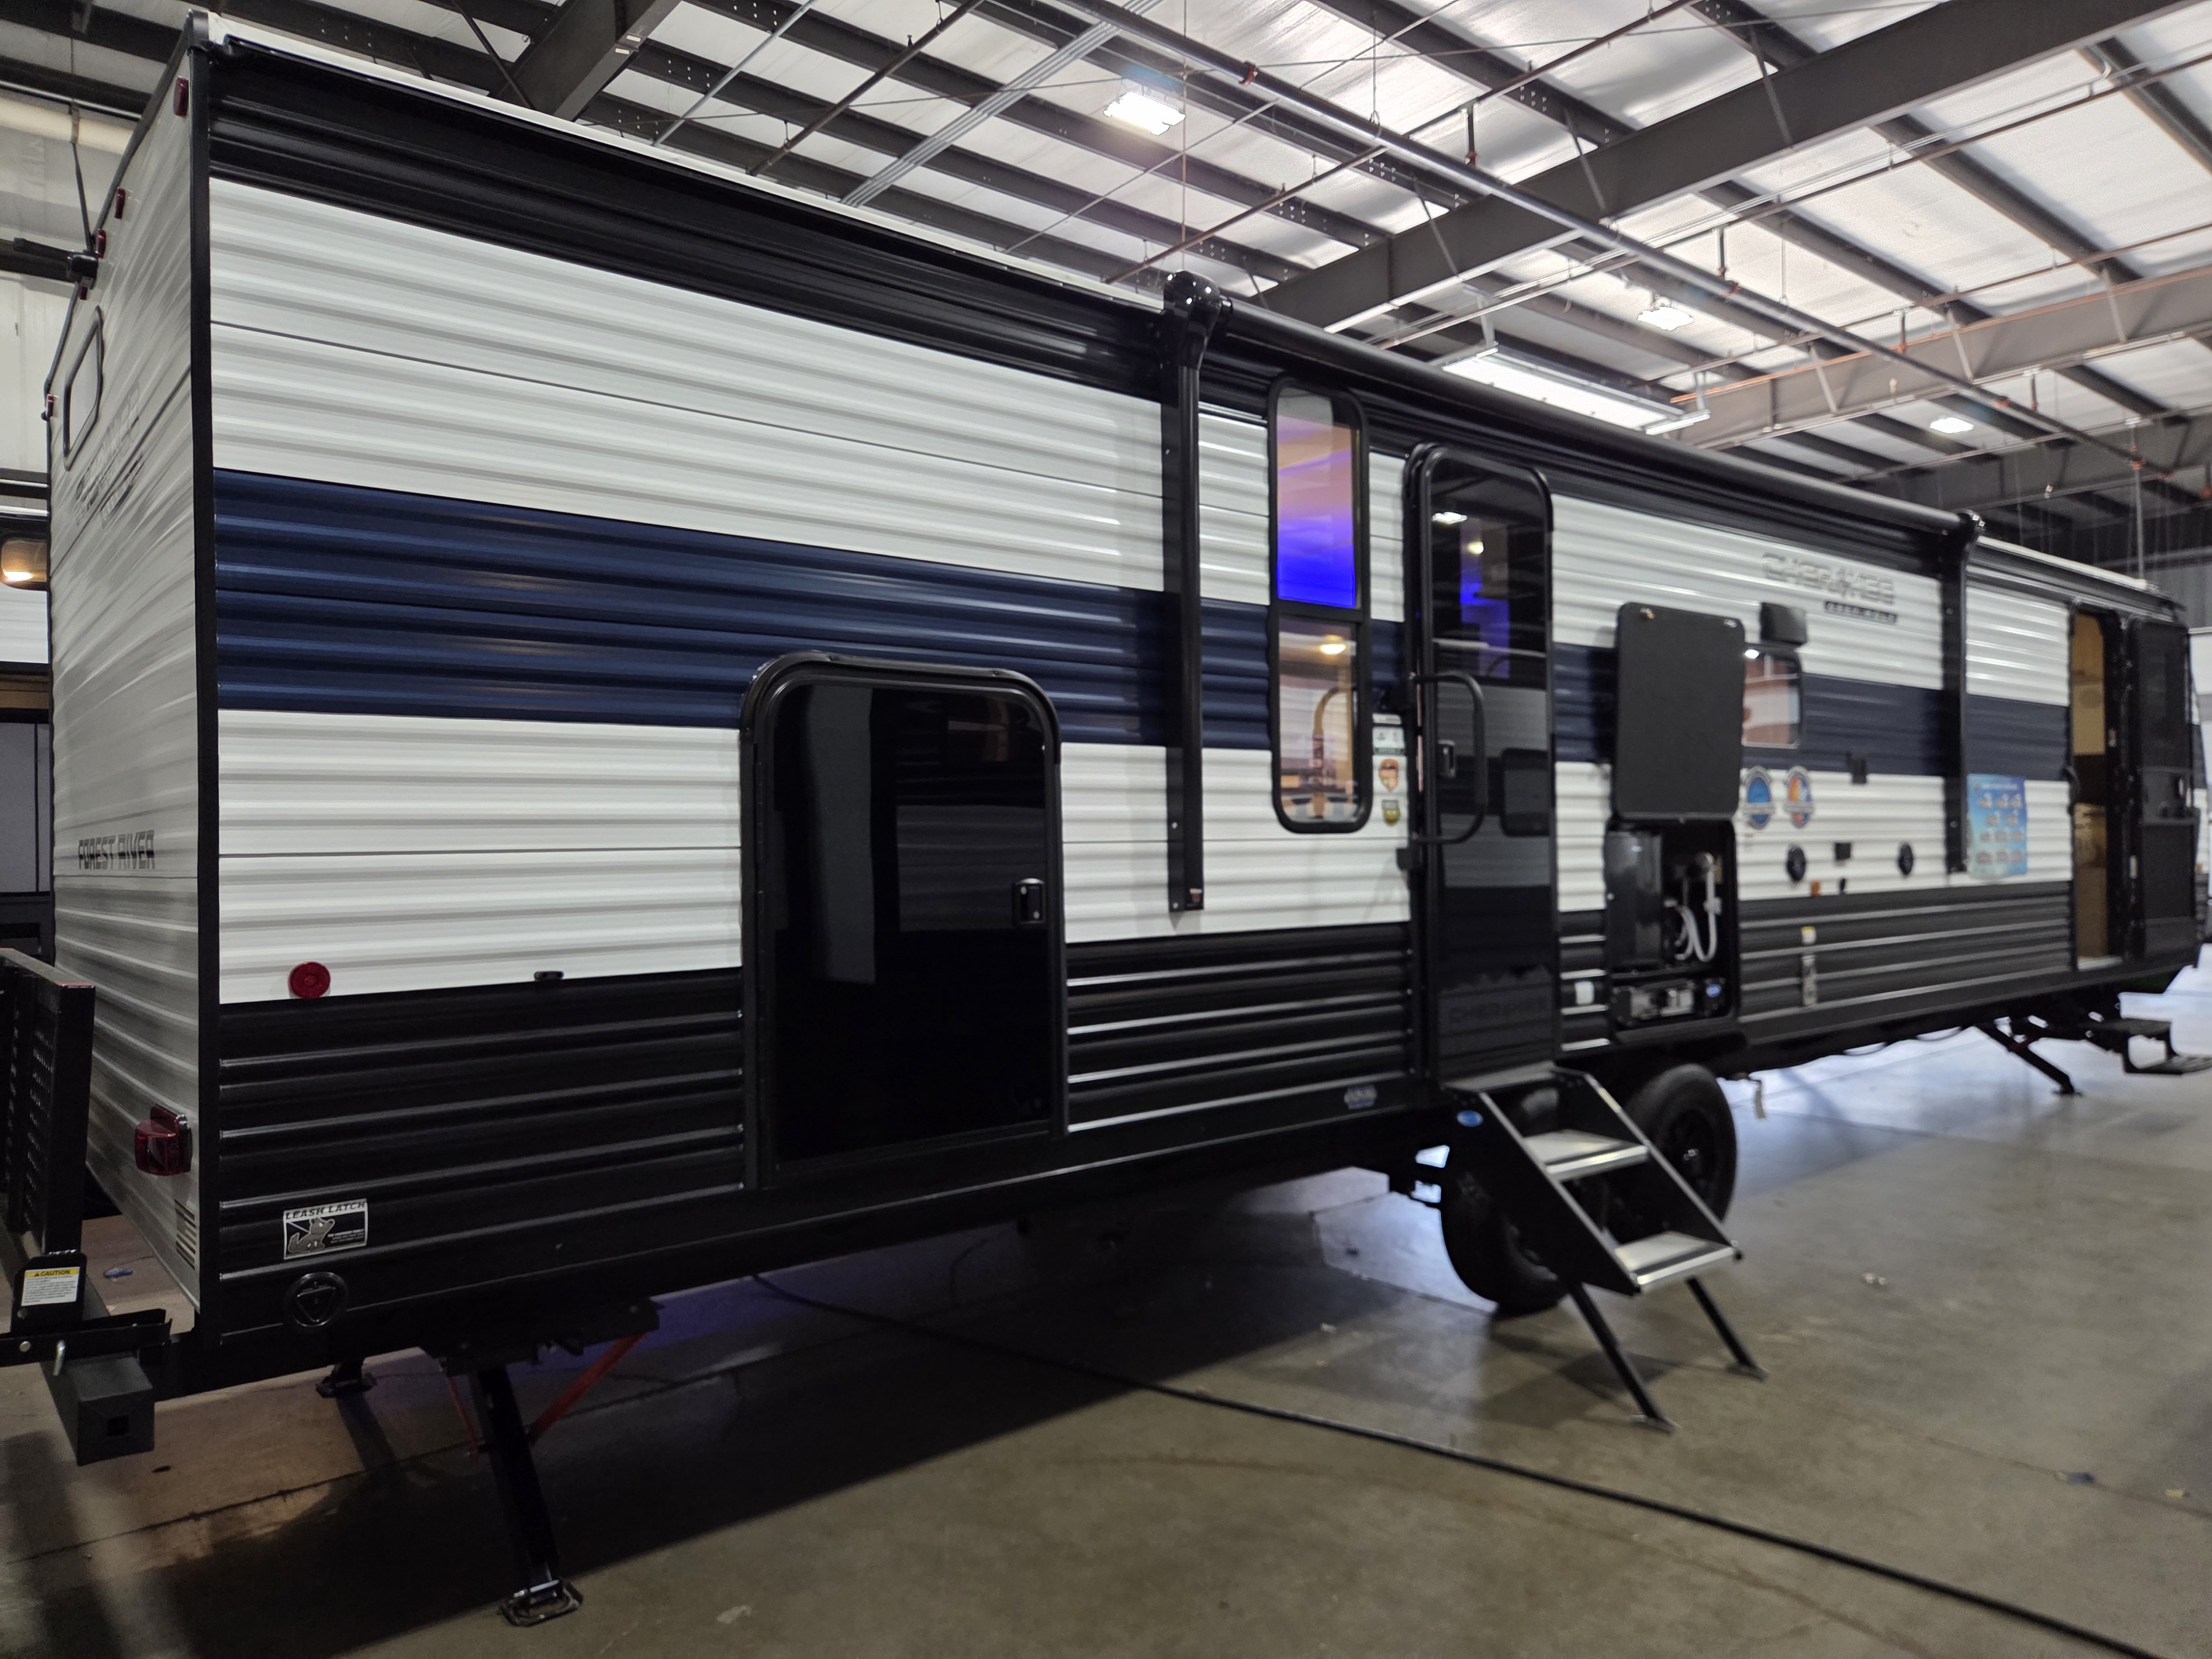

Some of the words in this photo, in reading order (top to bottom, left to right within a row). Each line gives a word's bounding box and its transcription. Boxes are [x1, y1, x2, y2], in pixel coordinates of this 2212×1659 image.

[79, 836, 116, 869] FOREST
[118, 830, 155, 869] RIVER
[286, 1207, 325, 1219] LEASH
[329, 1201, 366, 1213] LATCH
